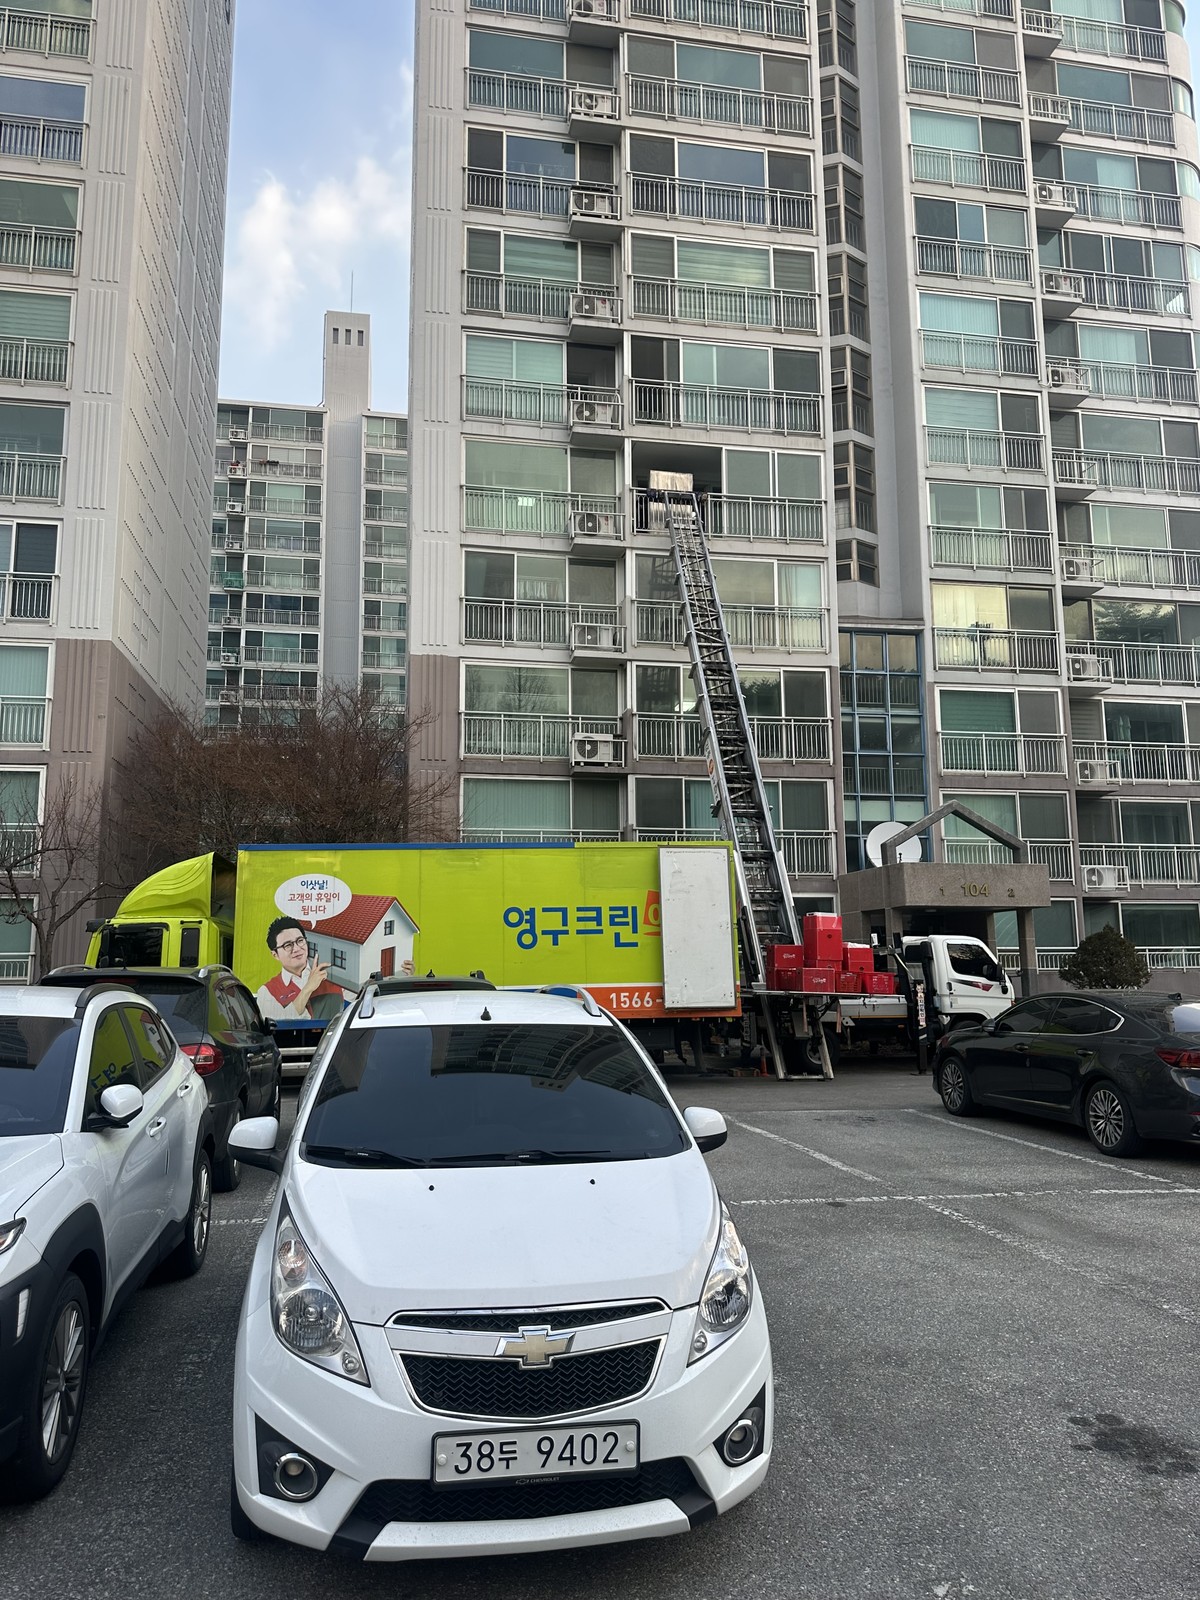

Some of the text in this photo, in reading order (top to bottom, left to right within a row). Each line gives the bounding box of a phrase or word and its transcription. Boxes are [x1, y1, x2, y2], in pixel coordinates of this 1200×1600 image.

[300, 879, 328, 891] 이삿날!
[961, 881, 990, 897] 104
[1007, 888, 1015, 898] 2
[288, 892, 340, 904] 고객의 휴일이
[301, 905, 327, 916] 됩니다
[454, 1431, 620, 1475] 38두 9402
